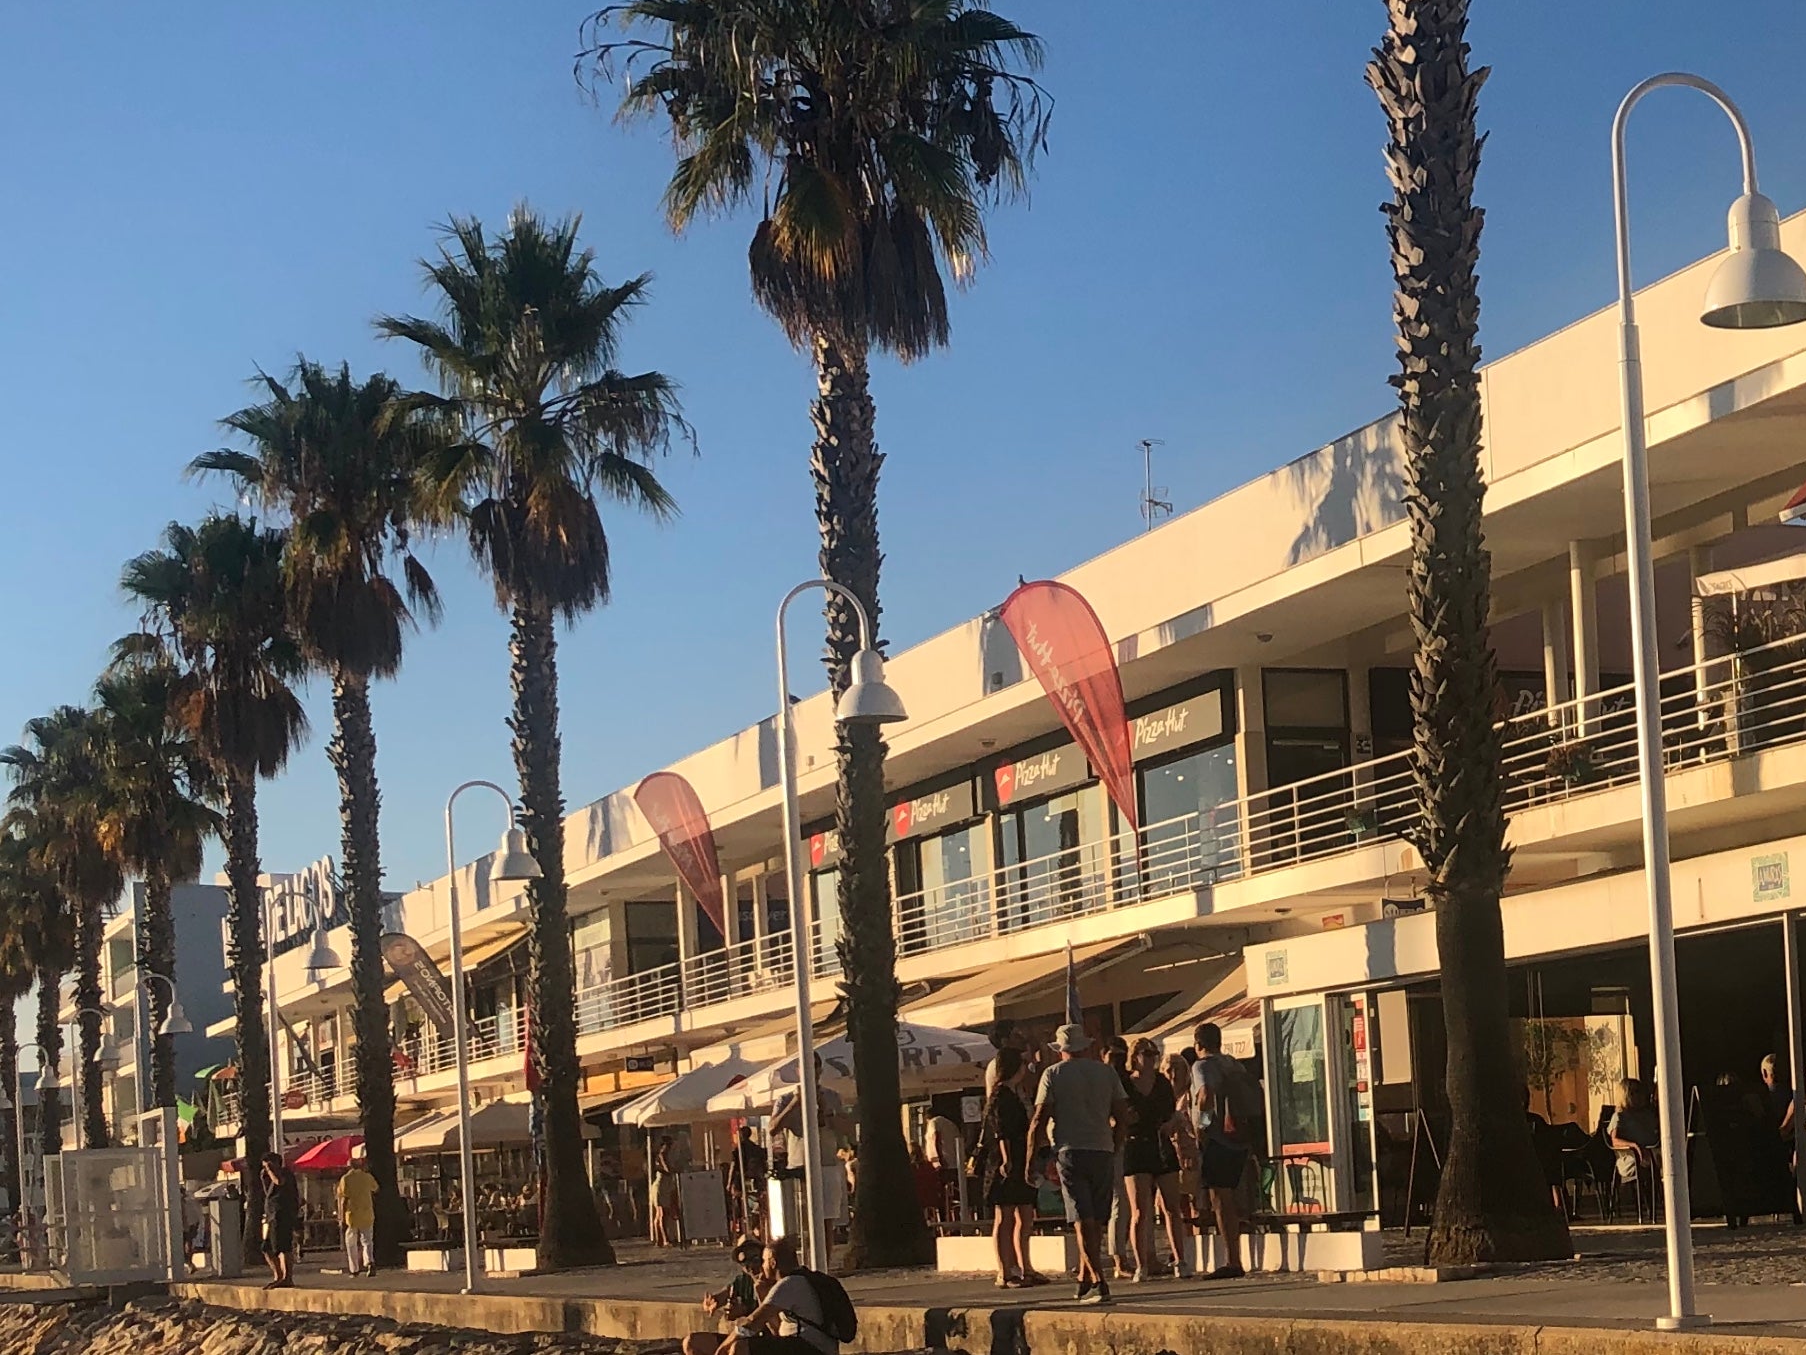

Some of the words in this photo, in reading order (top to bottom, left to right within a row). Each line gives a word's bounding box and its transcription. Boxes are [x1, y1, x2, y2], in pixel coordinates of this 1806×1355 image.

[1134, 717, 1167, 750] Pizza
[1164, 708, 1191, 737] Hut
[1014, 763, 1042, 791] Pizza
[1040, 754, 1062, 781] Hut
[910, 800, 934, 827] Pizza
[932, 793, 950, 816] Hut
[284, 855, 336, 936] LAGOS
